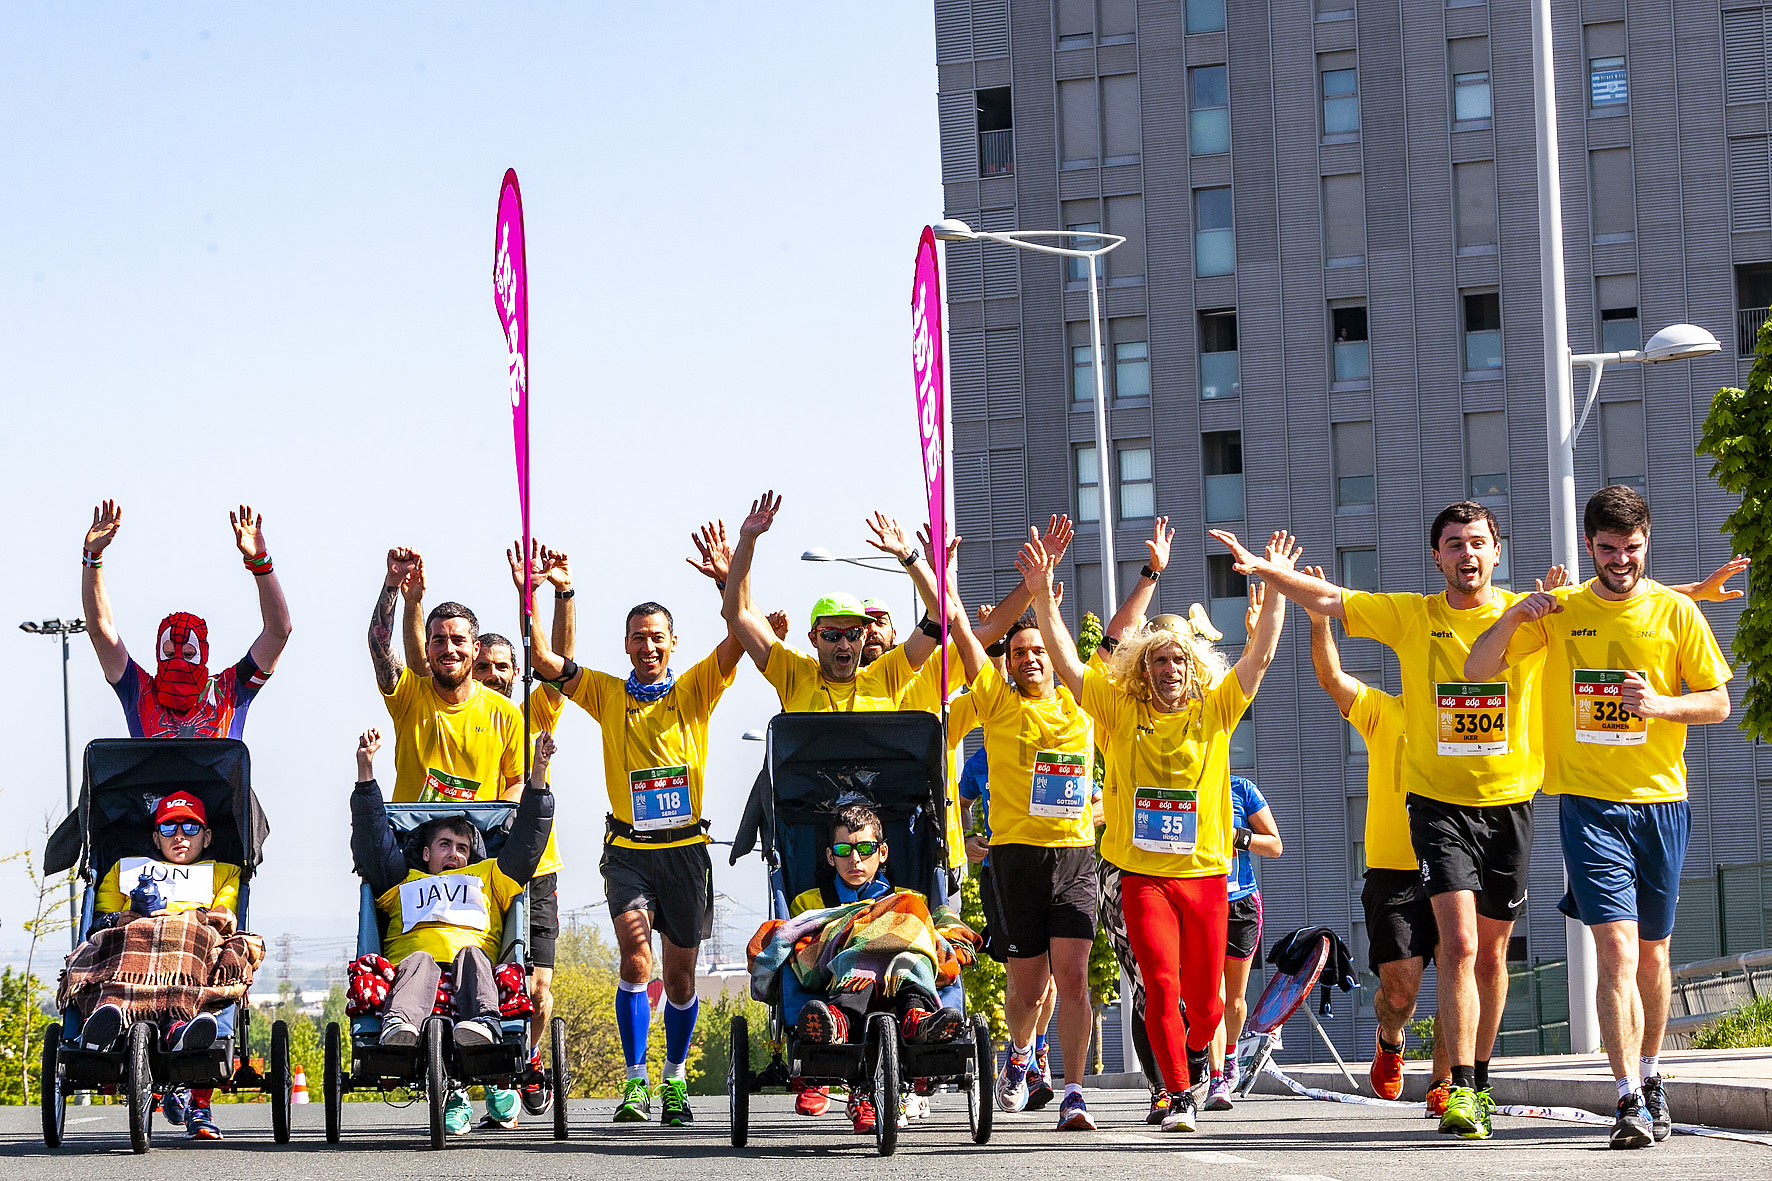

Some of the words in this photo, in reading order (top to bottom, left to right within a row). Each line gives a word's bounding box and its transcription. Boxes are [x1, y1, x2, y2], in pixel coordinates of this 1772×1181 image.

[1430, 630, 1454, 639] aefat
[1571, 628, 1597, 636] aefat
[1579, 684, 1594, 695] edp
[1603, 685, 1619, 696] edp
[1441, 697, 1456, 708] edp
[1465, 697, 1480, 708] edp
[1487, 696, 1502, 707] edp
[1454, 713, 1505, 733] 3304
[1037, 764, 1051, 773] edp
[1058, 766, 1071, 775] edp
[634, 781, 647, 790] edp
[654, 778, 667, 788] edp
[672, 777, 684, 786] edp
[444, 788, 457, 797] edp
[656, 791, 681, 811] 118
[1138, 799, 1151, 809] edp
[1159, 801, 1172, 810] edp
[1178, 801, 1192, 811] edp
[1161, 815, 1183, 834] 35
[416, 883, 468, 909] JAVI
